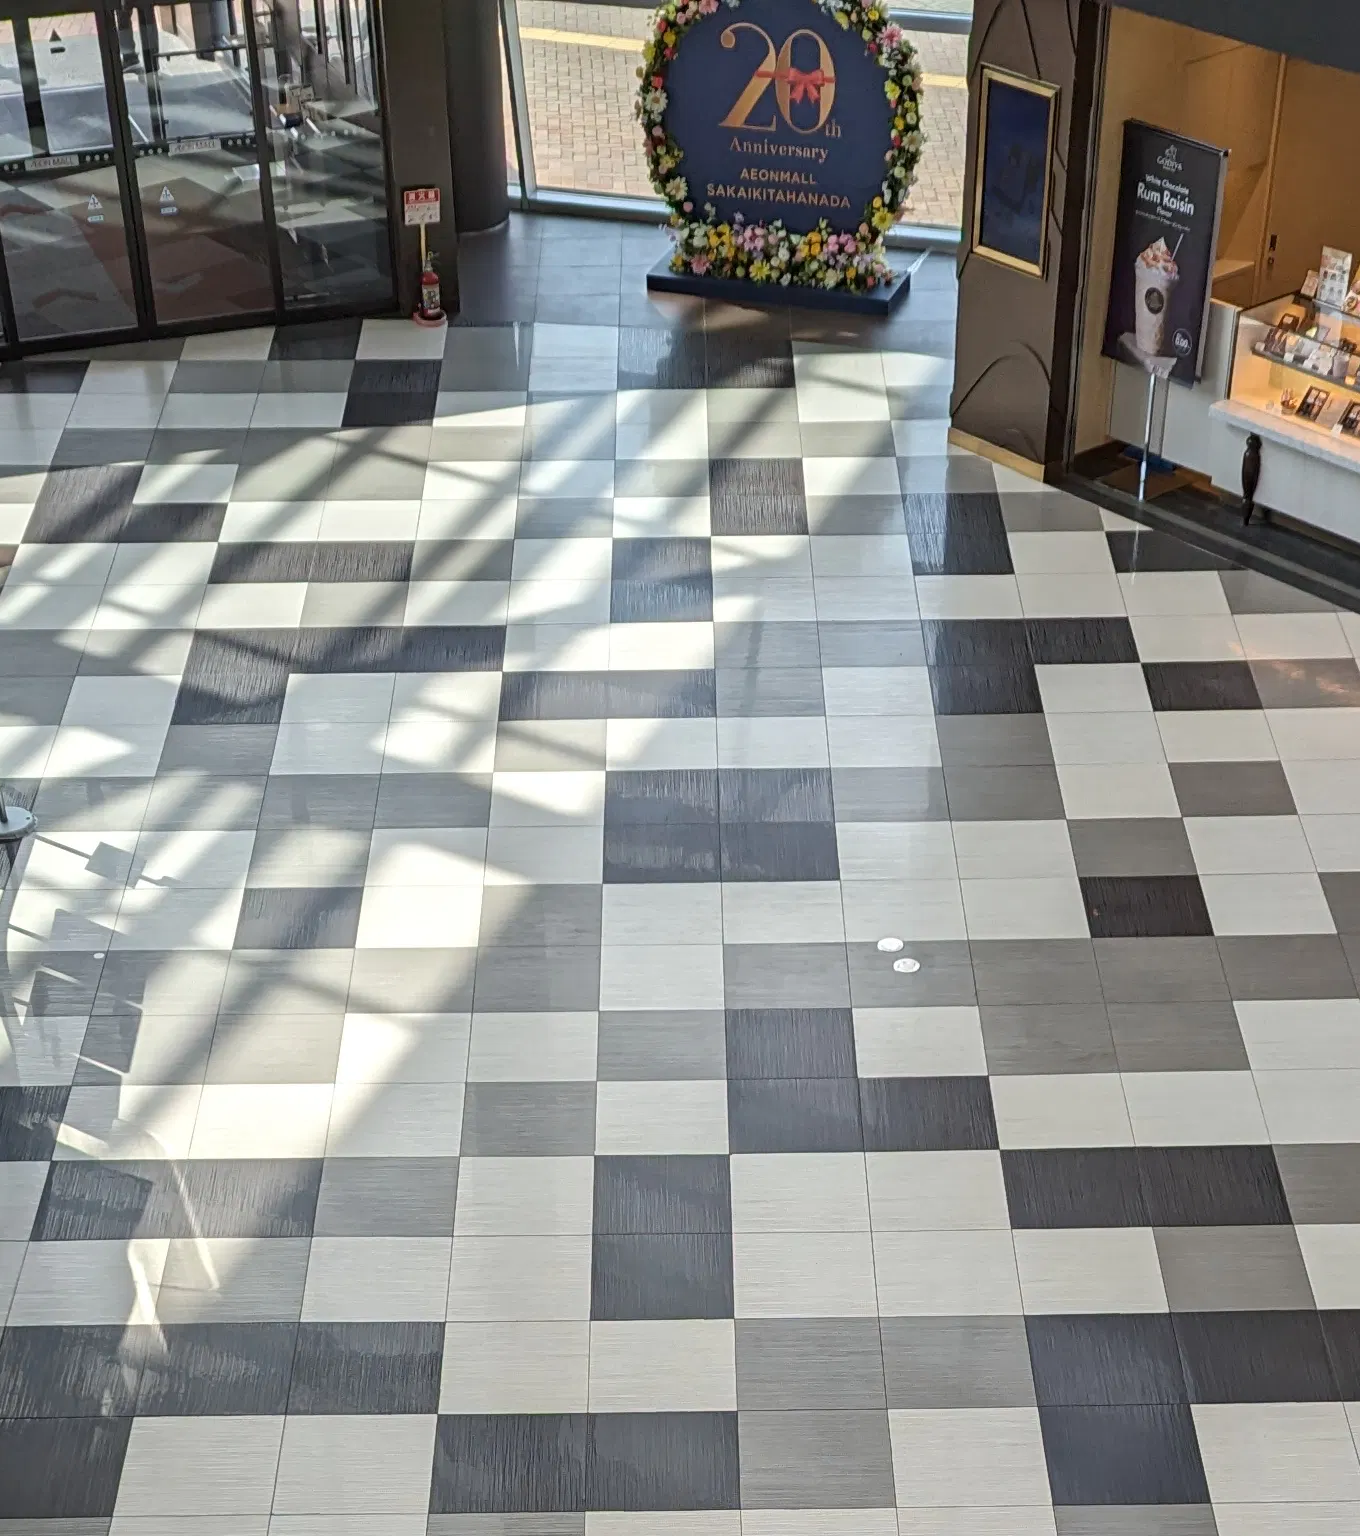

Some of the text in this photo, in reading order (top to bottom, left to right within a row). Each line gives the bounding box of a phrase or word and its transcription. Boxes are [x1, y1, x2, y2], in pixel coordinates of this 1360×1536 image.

[730, 137, 829, 164] Anniversary
[740, 167, 816, 186] AEONMALL
[707, 183, 851, 210] SAKAIKITAHANADA
[1137, 182, 1194, 216] Rum Raisin
